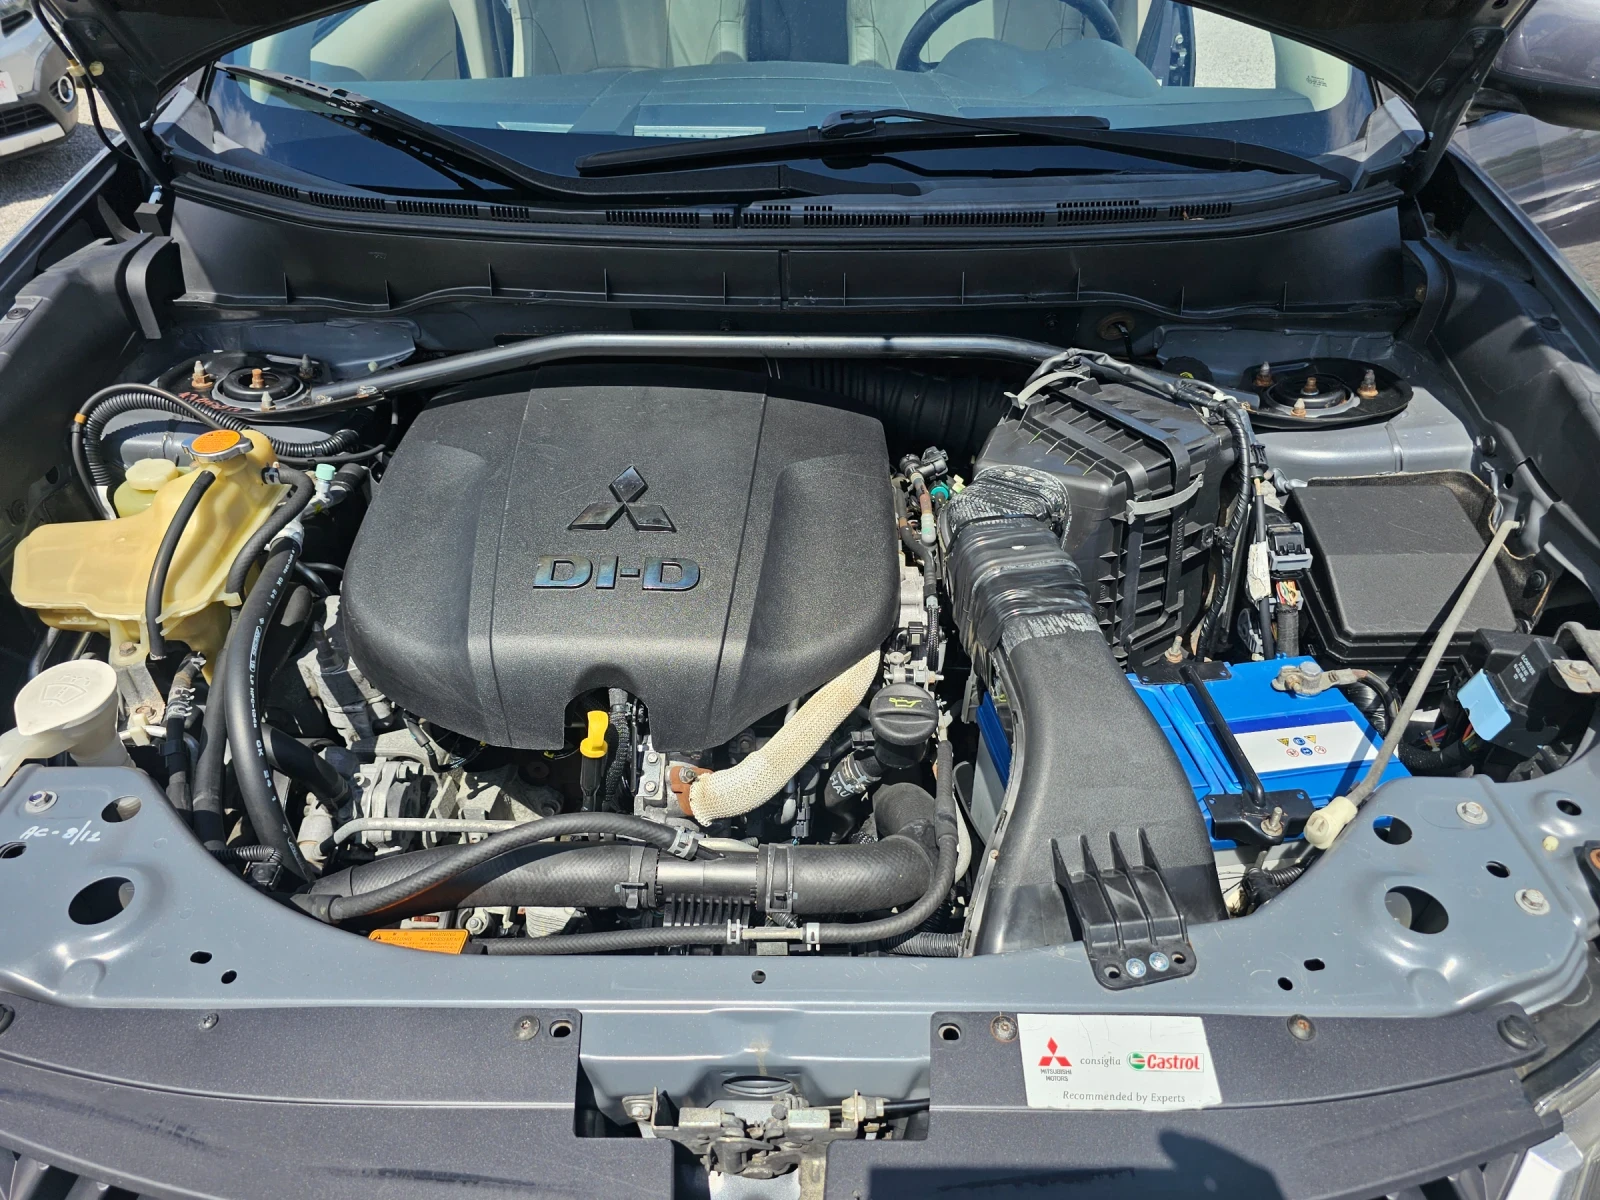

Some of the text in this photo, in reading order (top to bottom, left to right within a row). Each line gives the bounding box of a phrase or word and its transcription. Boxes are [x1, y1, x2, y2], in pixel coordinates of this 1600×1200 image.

[533, 555, 701, 592] DI-D
[1080, 1054, 1200, 1070] consiglia Castrol
[1063, 1090, 1186, 1104] Recommended by Experts
